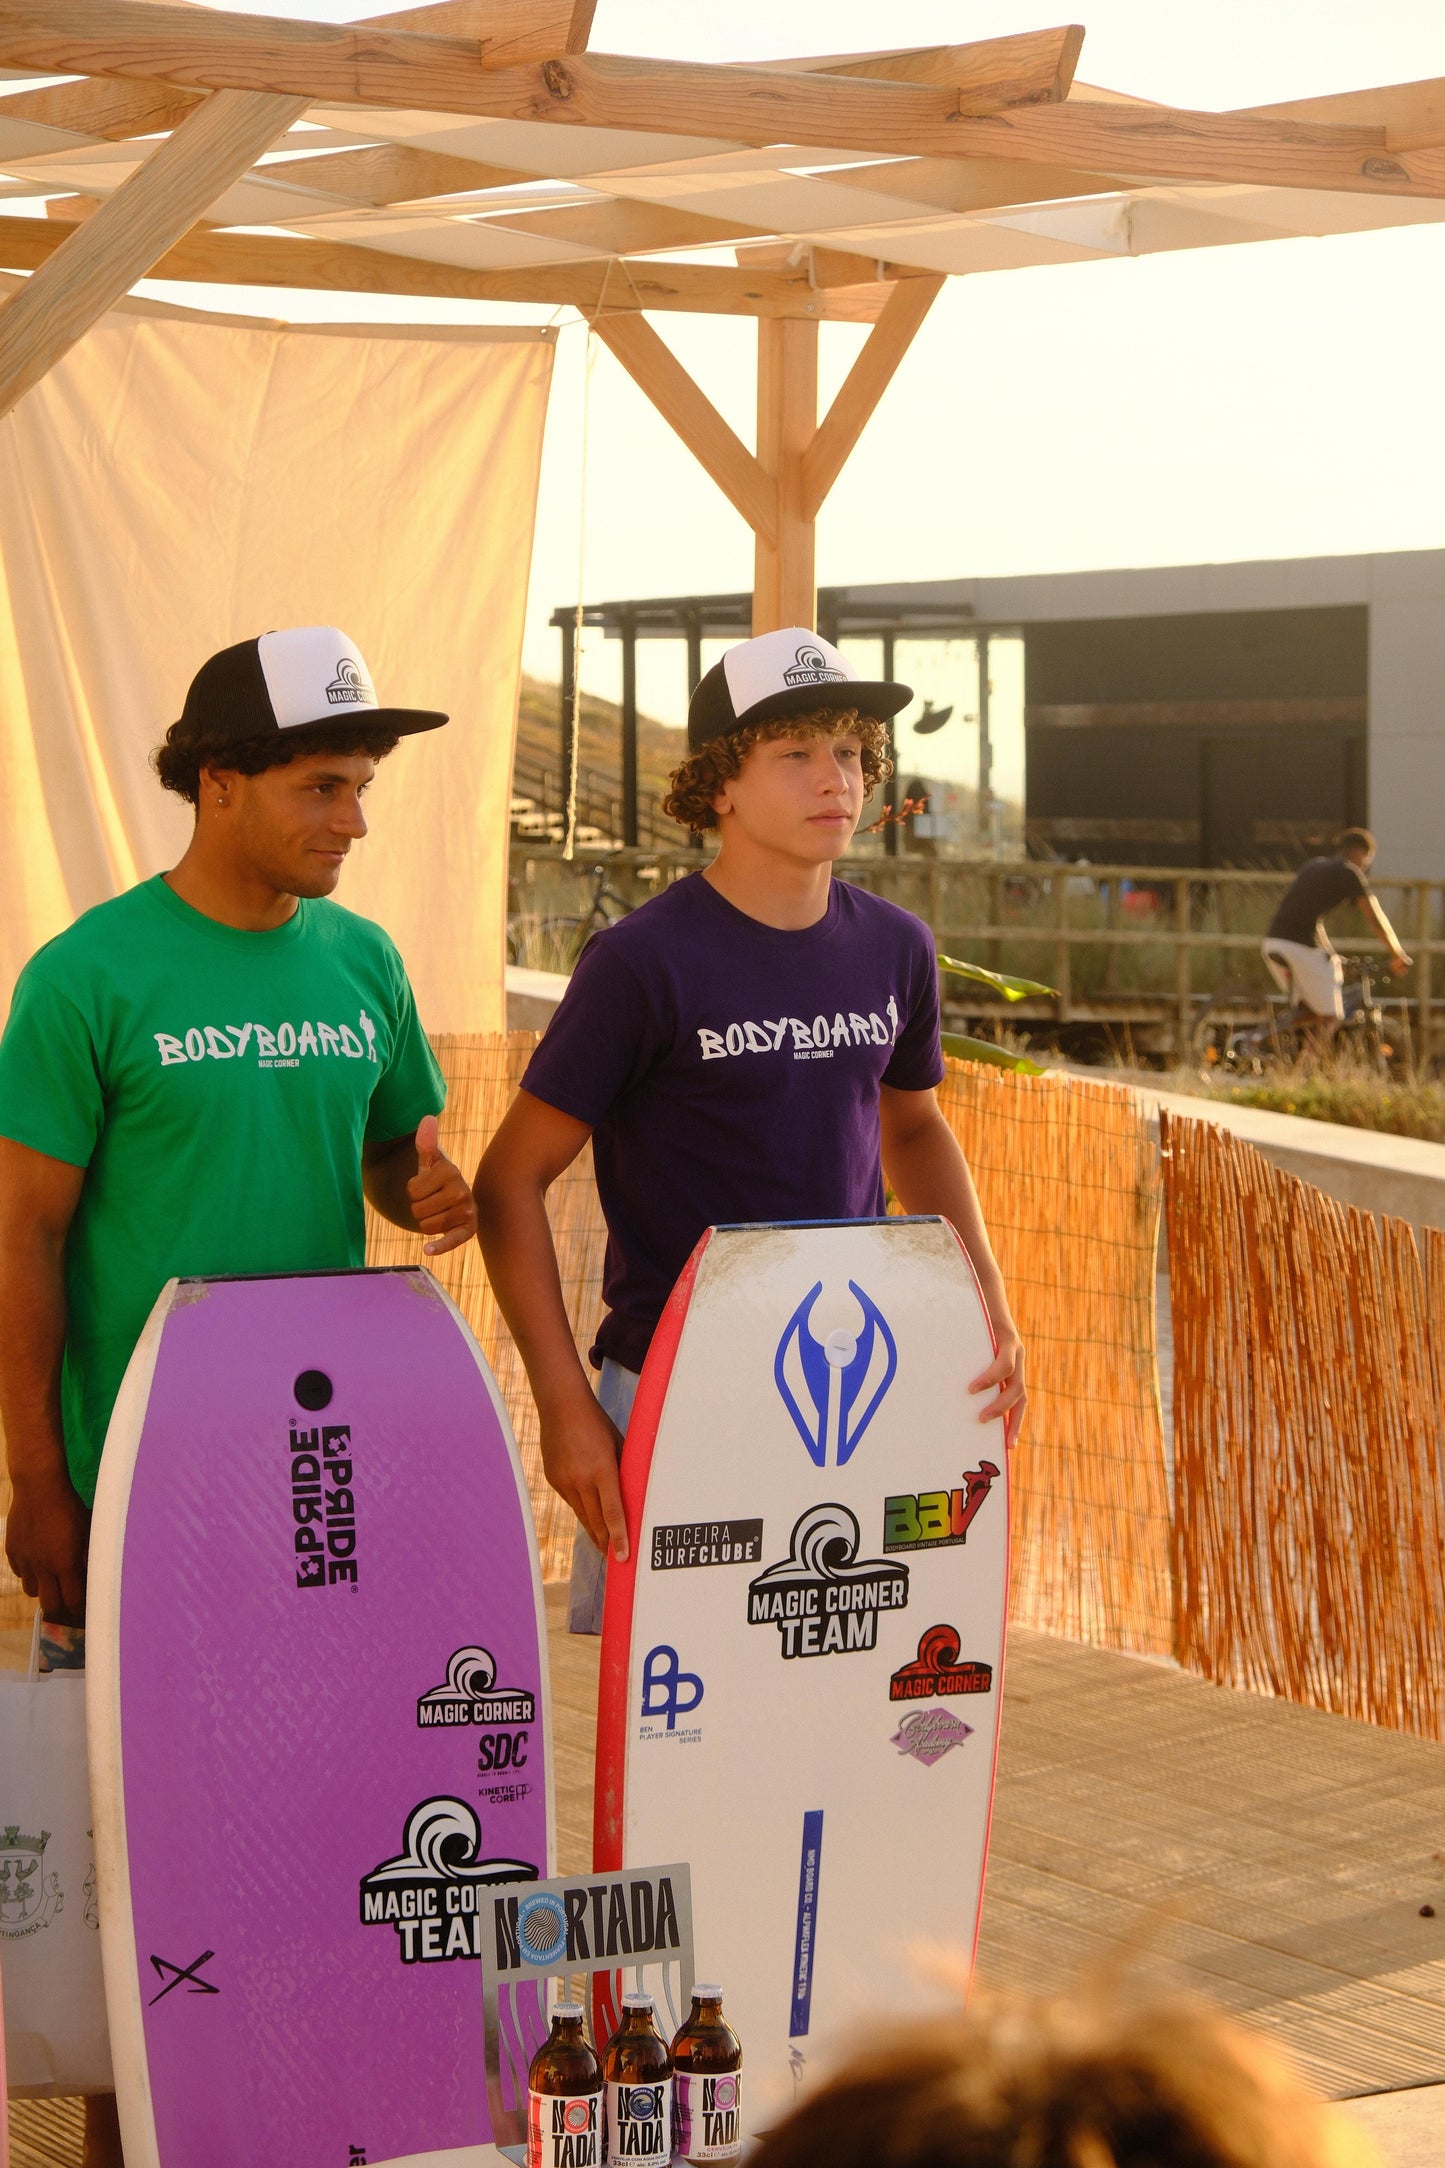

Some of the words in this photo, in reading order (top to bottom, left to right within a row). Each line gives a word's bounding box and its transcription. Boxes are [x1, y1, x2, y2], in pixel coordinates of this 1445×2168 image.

[785, 672, 817, 686] MAGIC
[327, 690, 357, 703] MAGIC
[154, 1020, 364, 1066] BODYBOARD
[697, 1012, 889, 1060] BODYBOARD
[258, 1060, 274, 1068] MAGIC
[274, 1059, 300, 1068] CORNER
[793, 1051, 811, 1060] MAGIC
[811, 1050, 834, 1059] CORNER
[883, 1486, 992, 1545] BBV
[655, 1524, 730, 1548] ERICEIRA
[885, 1543, 917, 1552] BODYBOARD
[917, 1541, 938, 1549] VINTAGE
[938, 1537, 965, 1546] PORTUGAL
[653, 1541, 754, 1567] SURFCLUBE
[751, 1588, 819, 1621] MAGIC
[825, 1579, 905, 1613] CORNER
[782, 1610, 873, 1656] TEAM
[891, 1677, 934, 1698] MAGIC
[937, 1673, 991, 1694] CORNER
[419, 1703, 469, 1724] MAGIC
[473, 1701, 532, 1722] CORNER
[640, 1732, 664, 1740] PLAYER
[665, 1728, 702, 1738] SIGNATURE
[679, 1736, 702, 1744] SERIES
[477, 1731, 529, 1771] SDC
[478, 1785, 515, 1797] KINETIC
[490, 1793, 515, 1804] CORE
[364, 1887, 438, 1921] MAGIC
[552, 2097, 597, 2134] NOR
[617, 2085, 665, 2120] NOR
[617, 2120, 664, 2156] TADA
[702, 2107, 740, 2147] TADA
[551, 2132, 597, 2168] TADA
